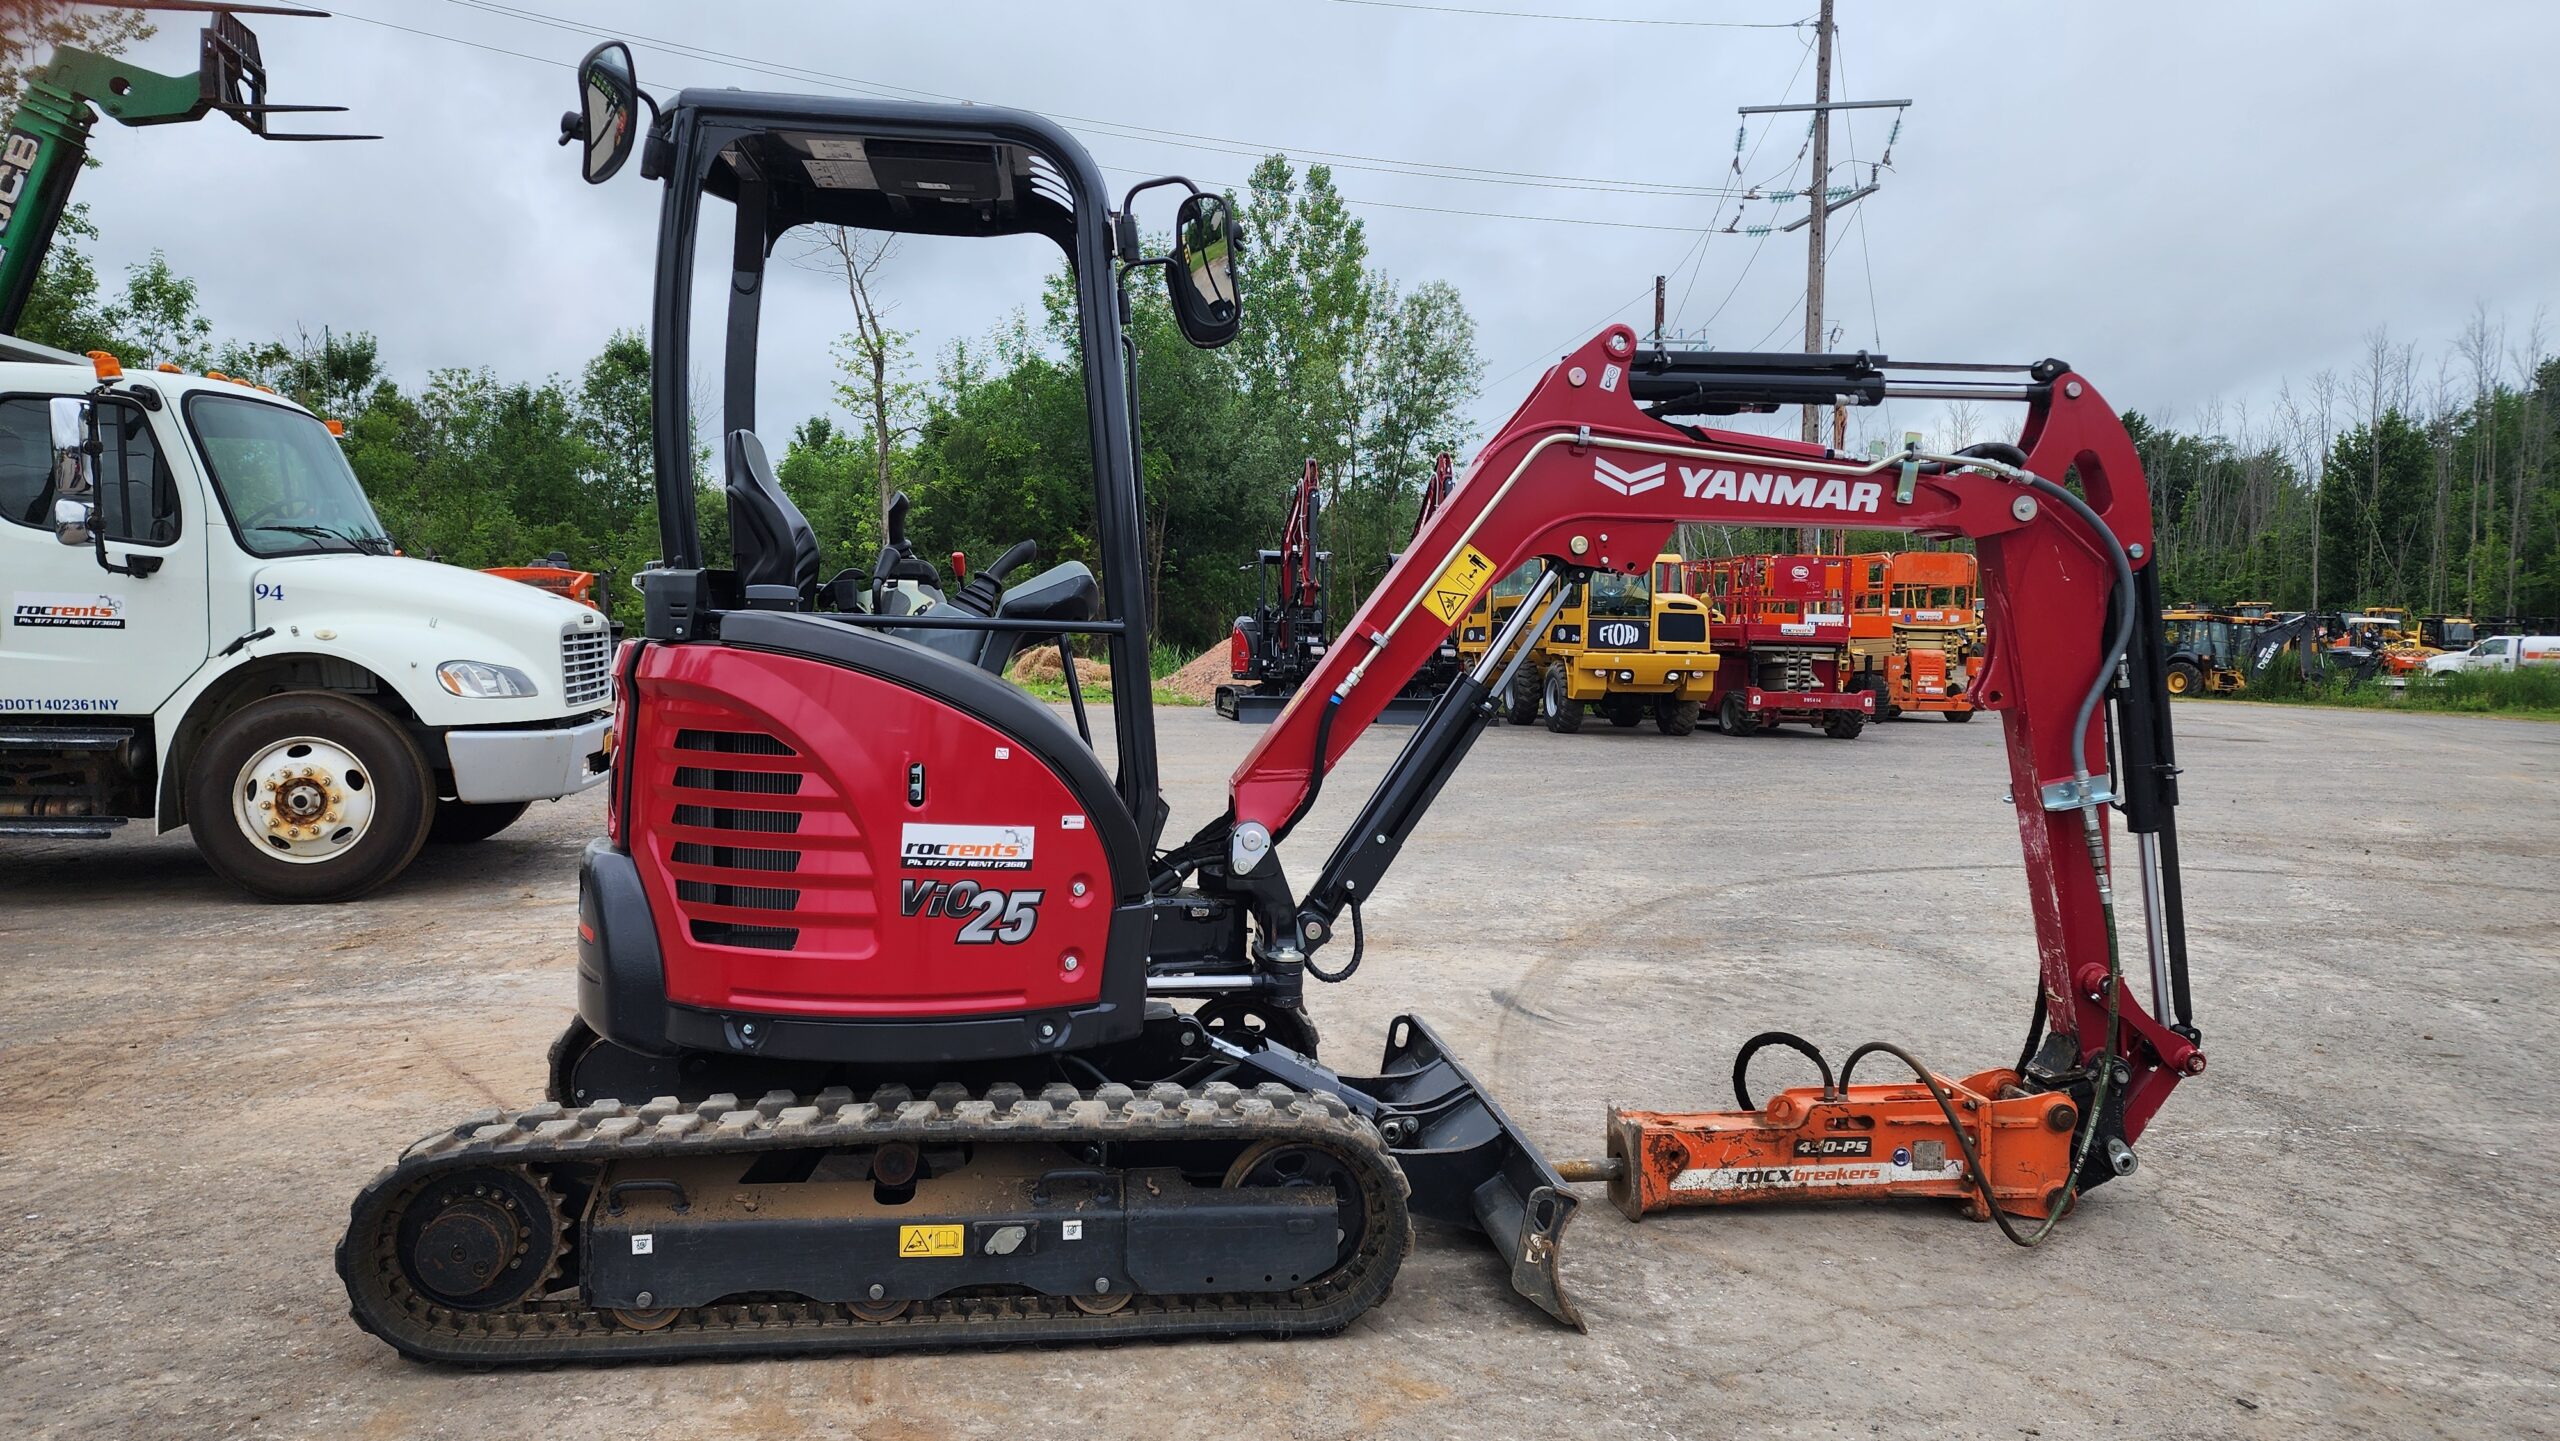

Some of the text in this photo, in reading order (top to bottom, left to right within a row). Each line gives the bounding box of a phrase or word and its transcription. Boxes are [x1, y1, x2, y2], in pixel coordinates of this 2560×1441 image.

[1678, 466, 1882, 513] YANMAR
[255, 583, 285, 601] 94
[17, 605, 113, 617] rocrents
[2257, 641, 2279, 670] DEERE
[905, 842, 1019, 857] rocrents
[906, 858, 922, 866] Ph.
[925, 859, 947, 867] 877
[966, 860, 994, 868] RENT
[994, 861, 1027, 869] (7368)
